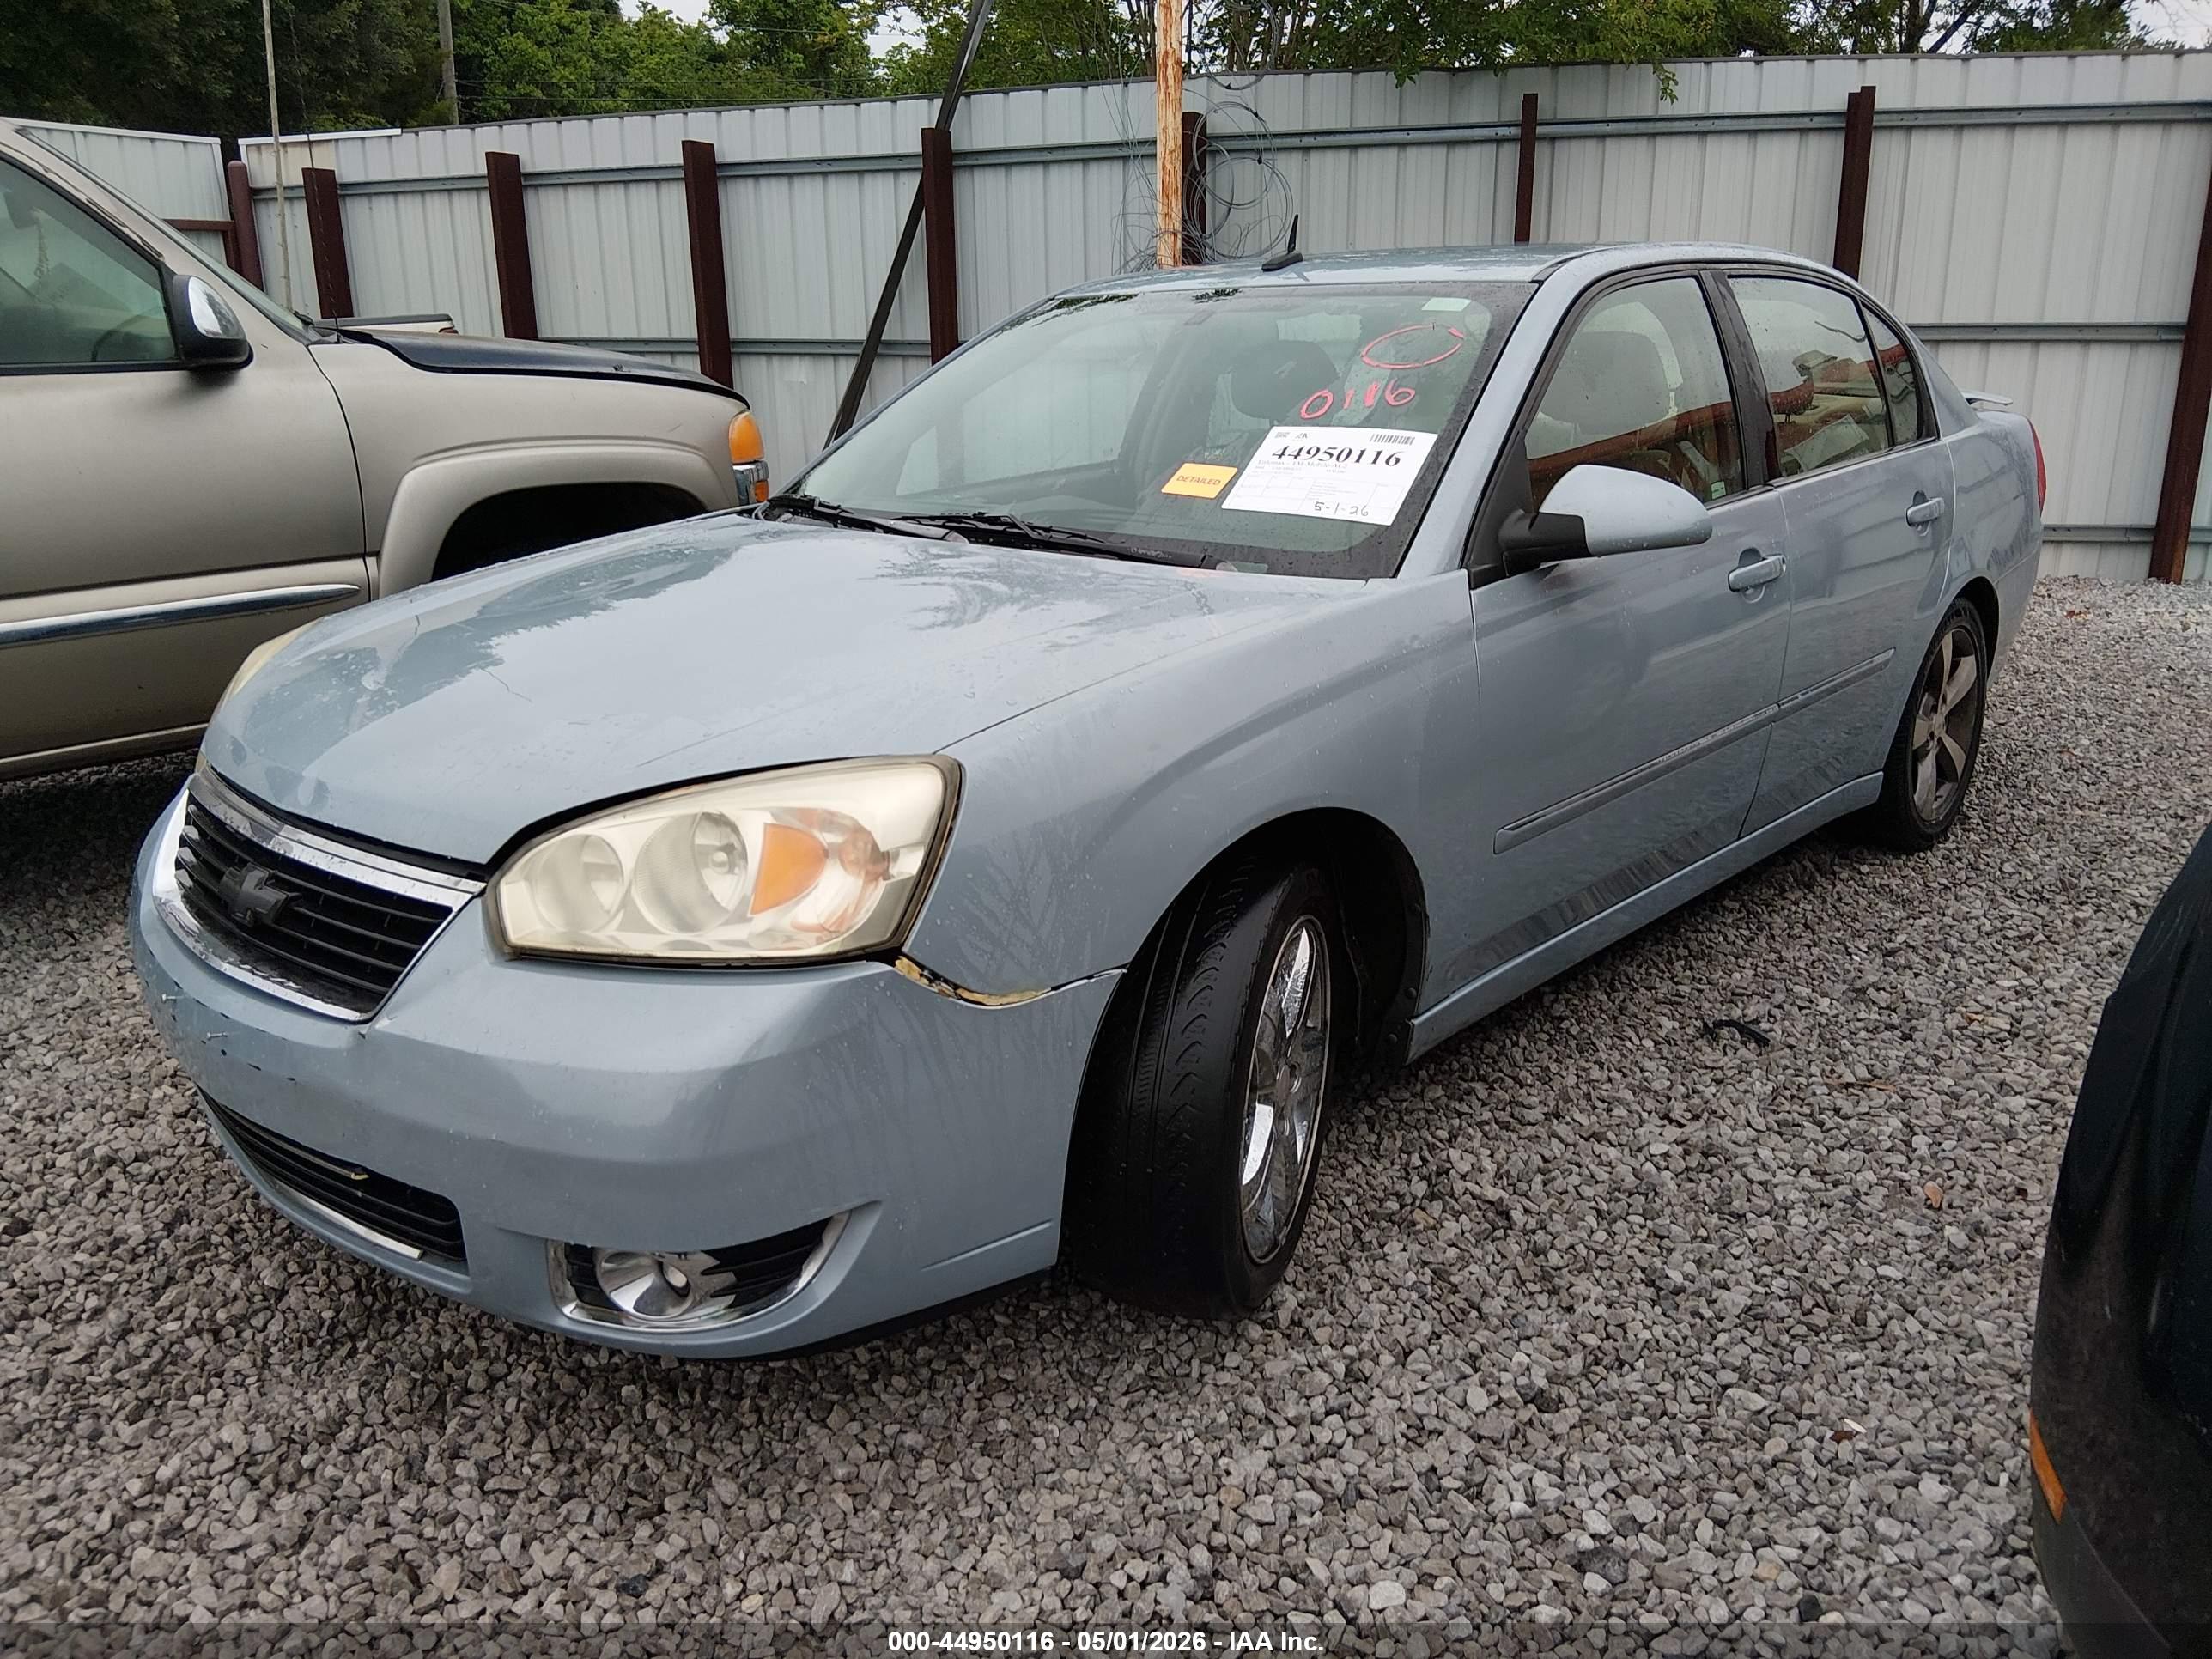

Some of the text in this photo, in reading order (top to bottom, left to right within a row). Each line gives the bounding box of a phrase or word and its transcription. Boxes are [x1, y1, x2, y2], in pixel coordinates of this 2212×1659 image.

[1300, 378, 1416, 419] 0116
[1272, 445, 1405, 467] 44950116
[1176, 475, 1221, 486] DETAILED
